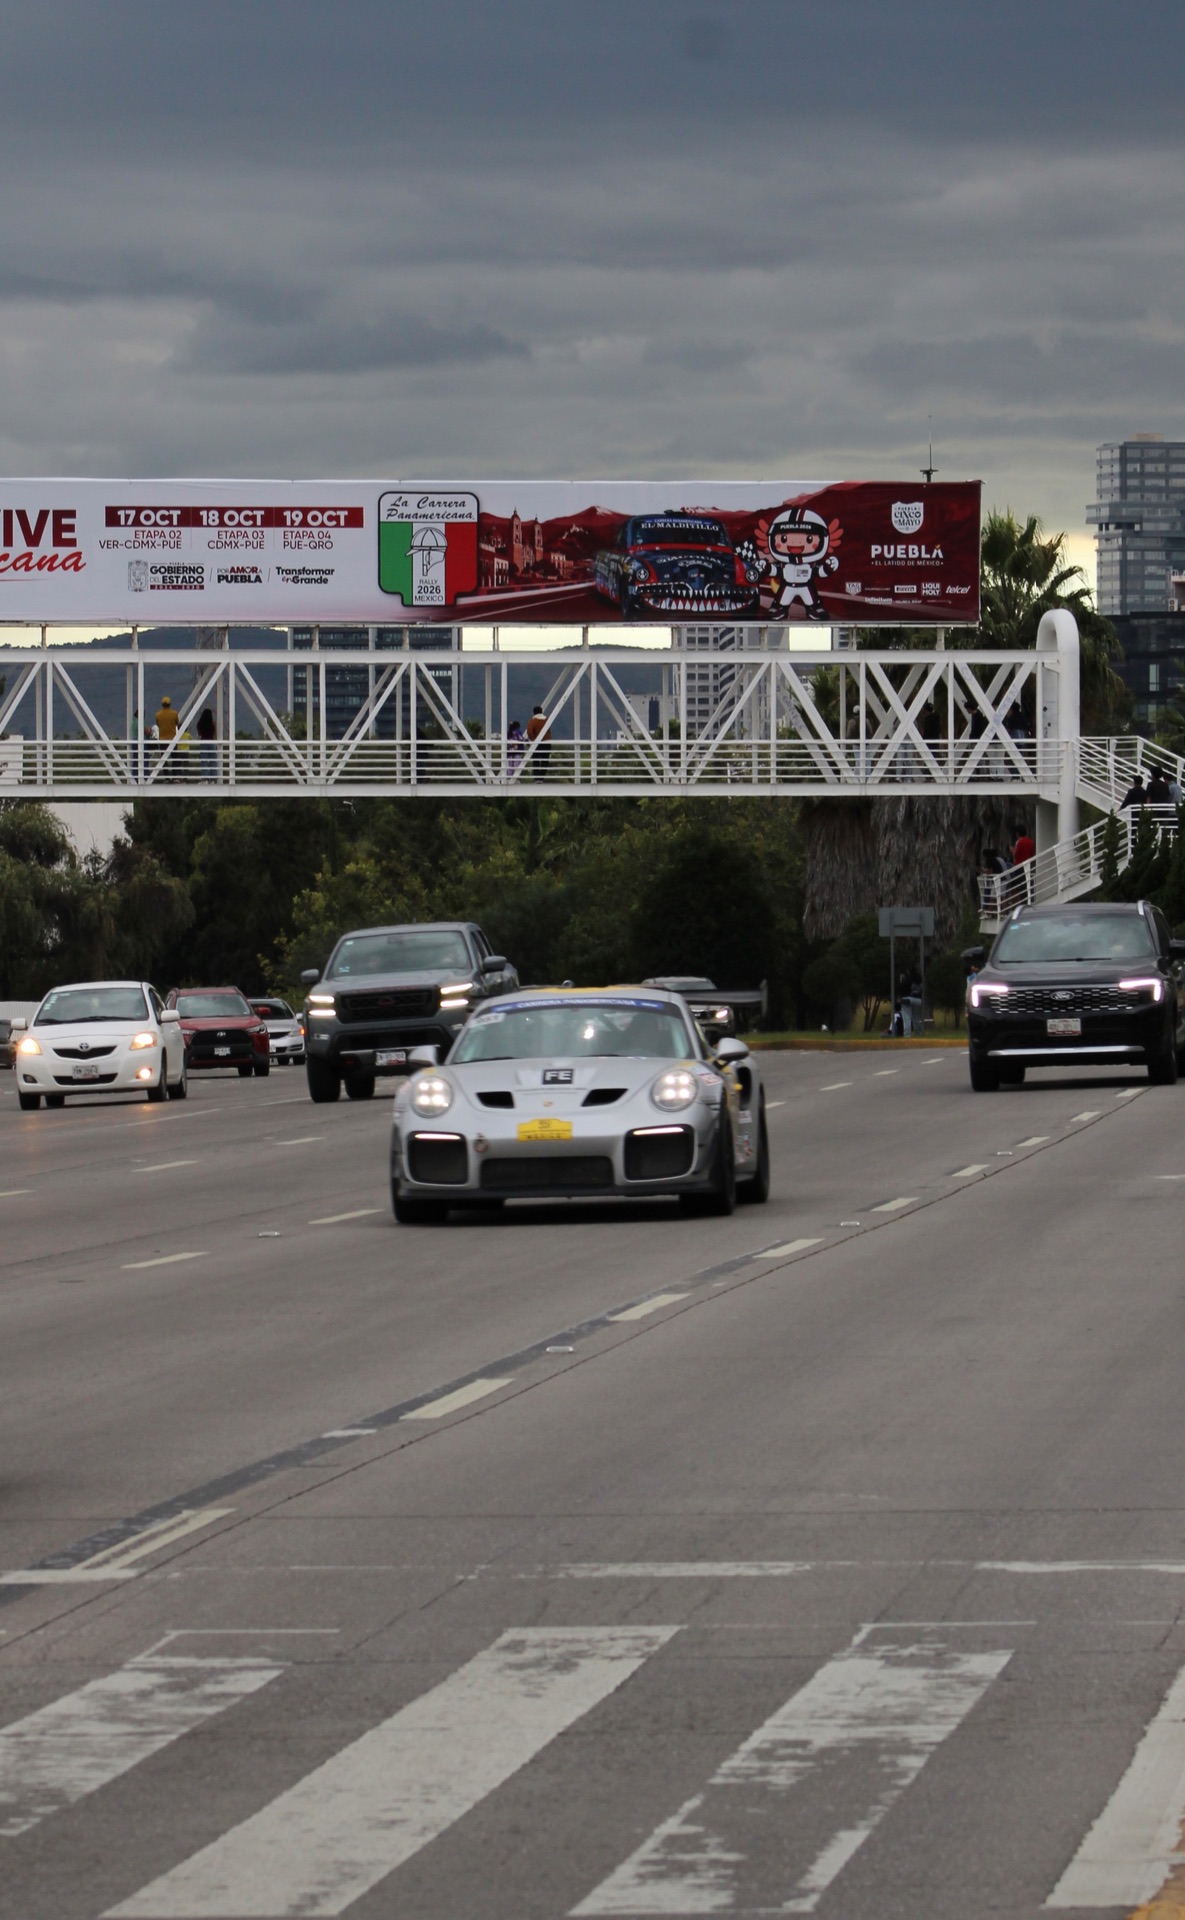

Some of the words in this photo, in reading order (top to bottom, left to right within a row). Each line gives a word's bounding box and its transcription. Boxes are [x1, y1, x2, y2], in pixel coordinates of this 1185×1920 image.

[391, 496, 409, 507] La
[417, 496, 467, 509] Carrera
[117, 510, 136, 526] 17
[140, 510, 181, 526] OCT
[200, 510, 219, 526] 18
[223, 510, 264, 526] OCT
[283, 510, 303, 526] 19
[307, 510, 348, 526] OCT
[386, 508, 472, 520] Panamericana
[894, 511, 921, 519] CINCO
[0, 509, 77, 548] IVE
[656, 522, 719, 531] MALDITILLO
[134, 530, 166, 539] ETAPA
[169, 530, 182, 539] 02
[217, 530, 249, 539] ETAPA
[252, 530, 264, 540] 03
[283, 530, 314, 540] ETAPA
[317, 530, 331, 540] 04
[99, 540, 182, 549] VER-CDMX-PUE
[207, 540, 264, 549] CDMX-PUE
[283, 540, 333, 550] PUE-QRO
[150, 566, 204, 575] GOBIERNO
[229, 566, 258, 574] AMOR
[276, 567, 335, 575] Transformar
[162, 576, 204, 584] ESTADO
[218, 575, 262, 583] PUEBLA
[292, 576, 329, 584] Grande
[418, 586, 441, 594] 2026
[946, 585, 971, 594] telcel
[545, 1071, 572, 1081] FE
